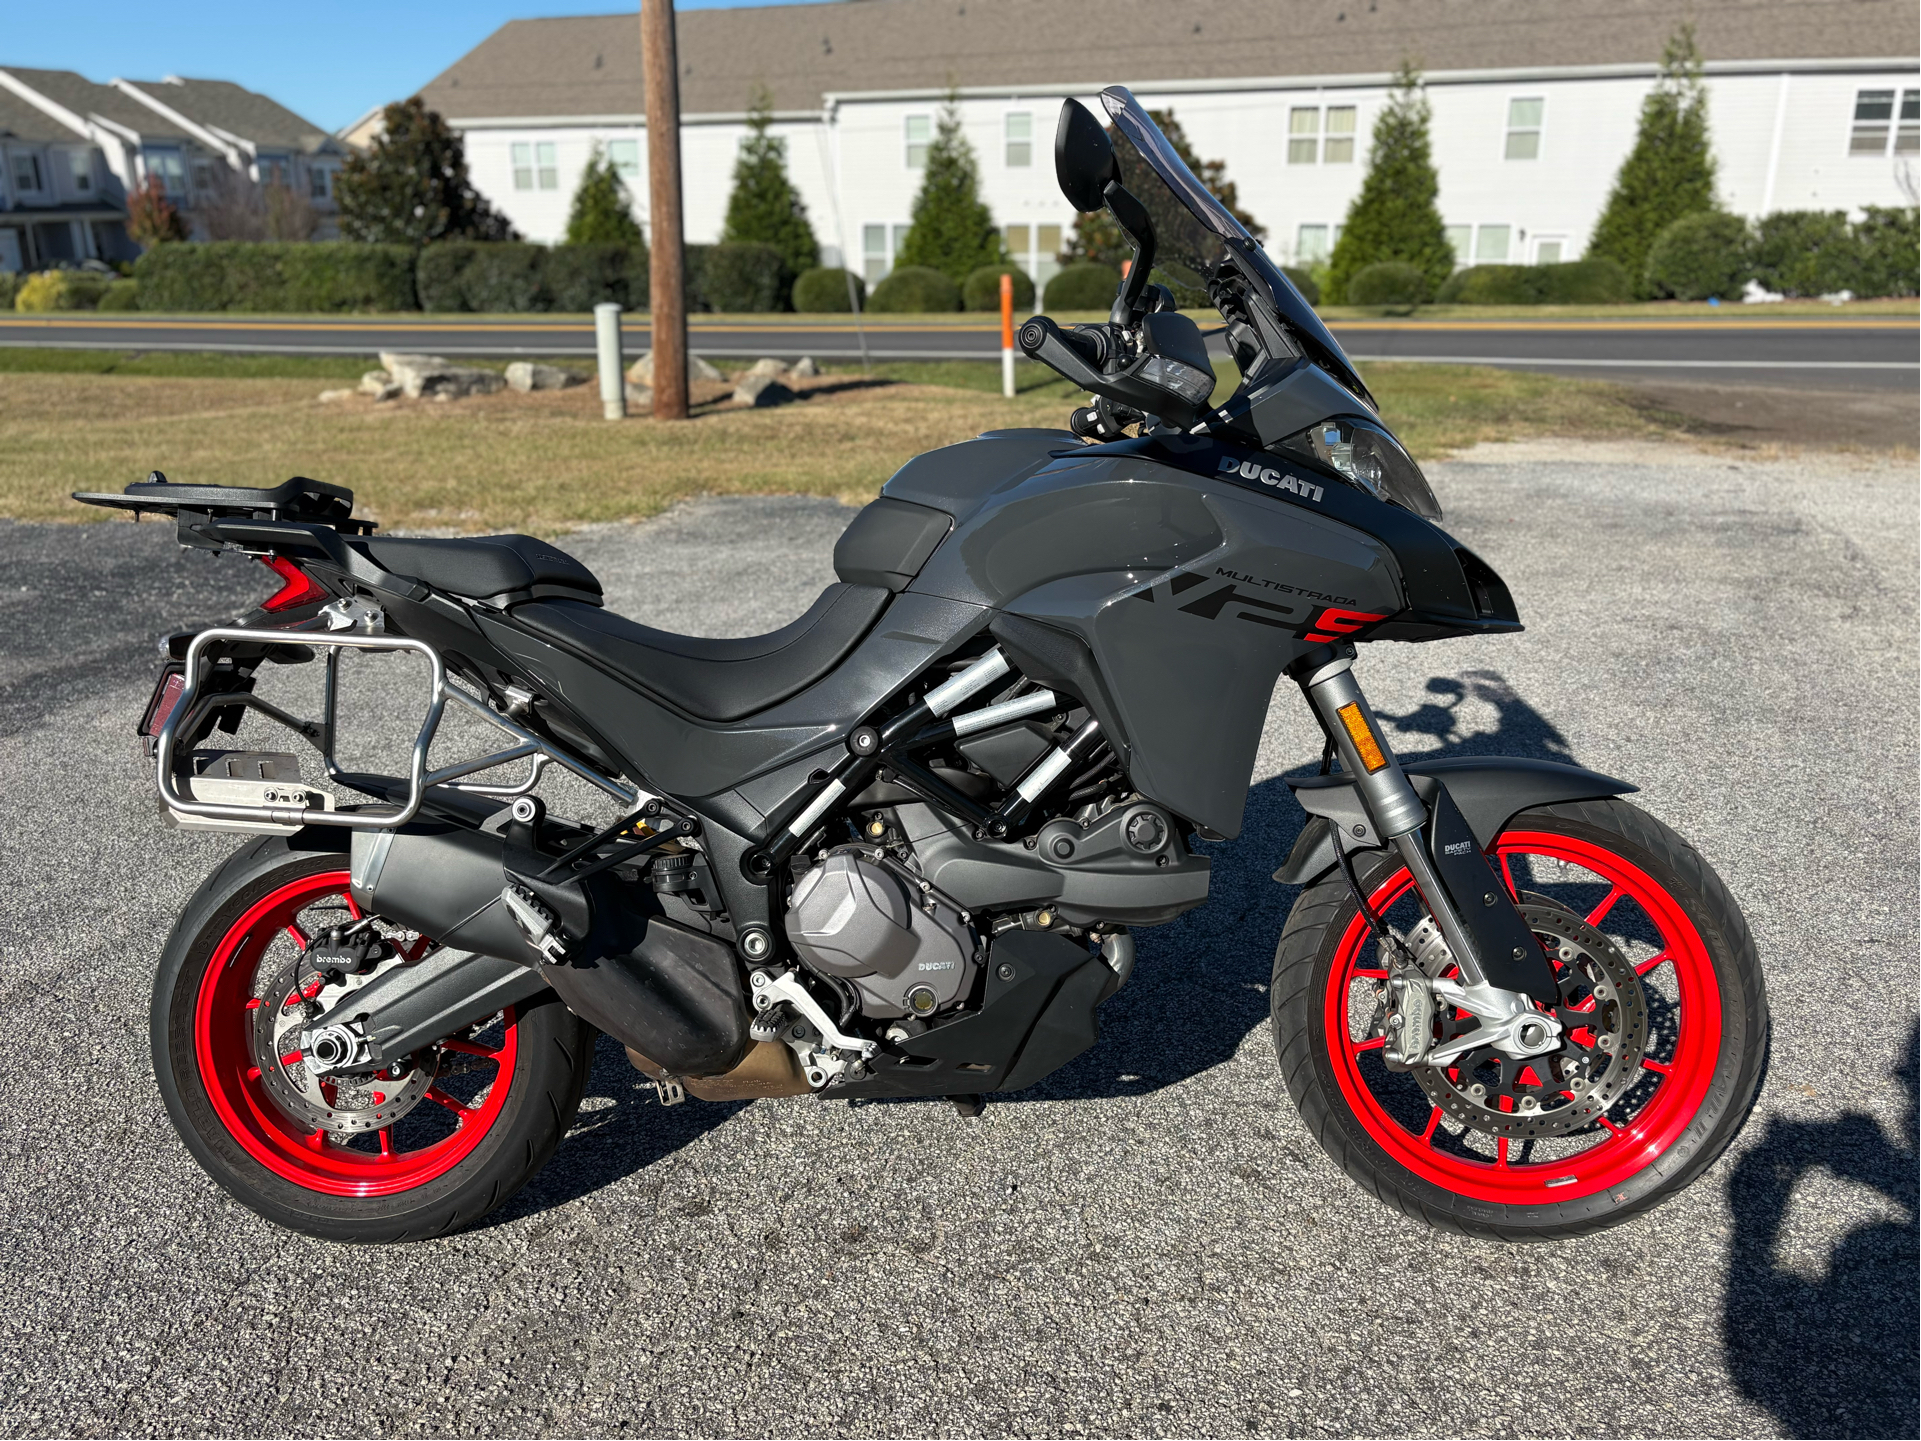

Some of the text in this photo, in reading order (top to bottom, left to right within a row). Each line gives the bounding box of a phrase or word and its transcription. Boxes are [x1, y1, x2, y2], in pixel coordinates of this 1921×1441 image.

[1217, 456, 1324, 502] DUCATI
[1215, 567, 1357, 607] MULTISTRADA
[1444, 841, 1470, 851] DUCATI
[316, 954, 352, 964] brembo
[918, 961, 955, 971] DUCATI
